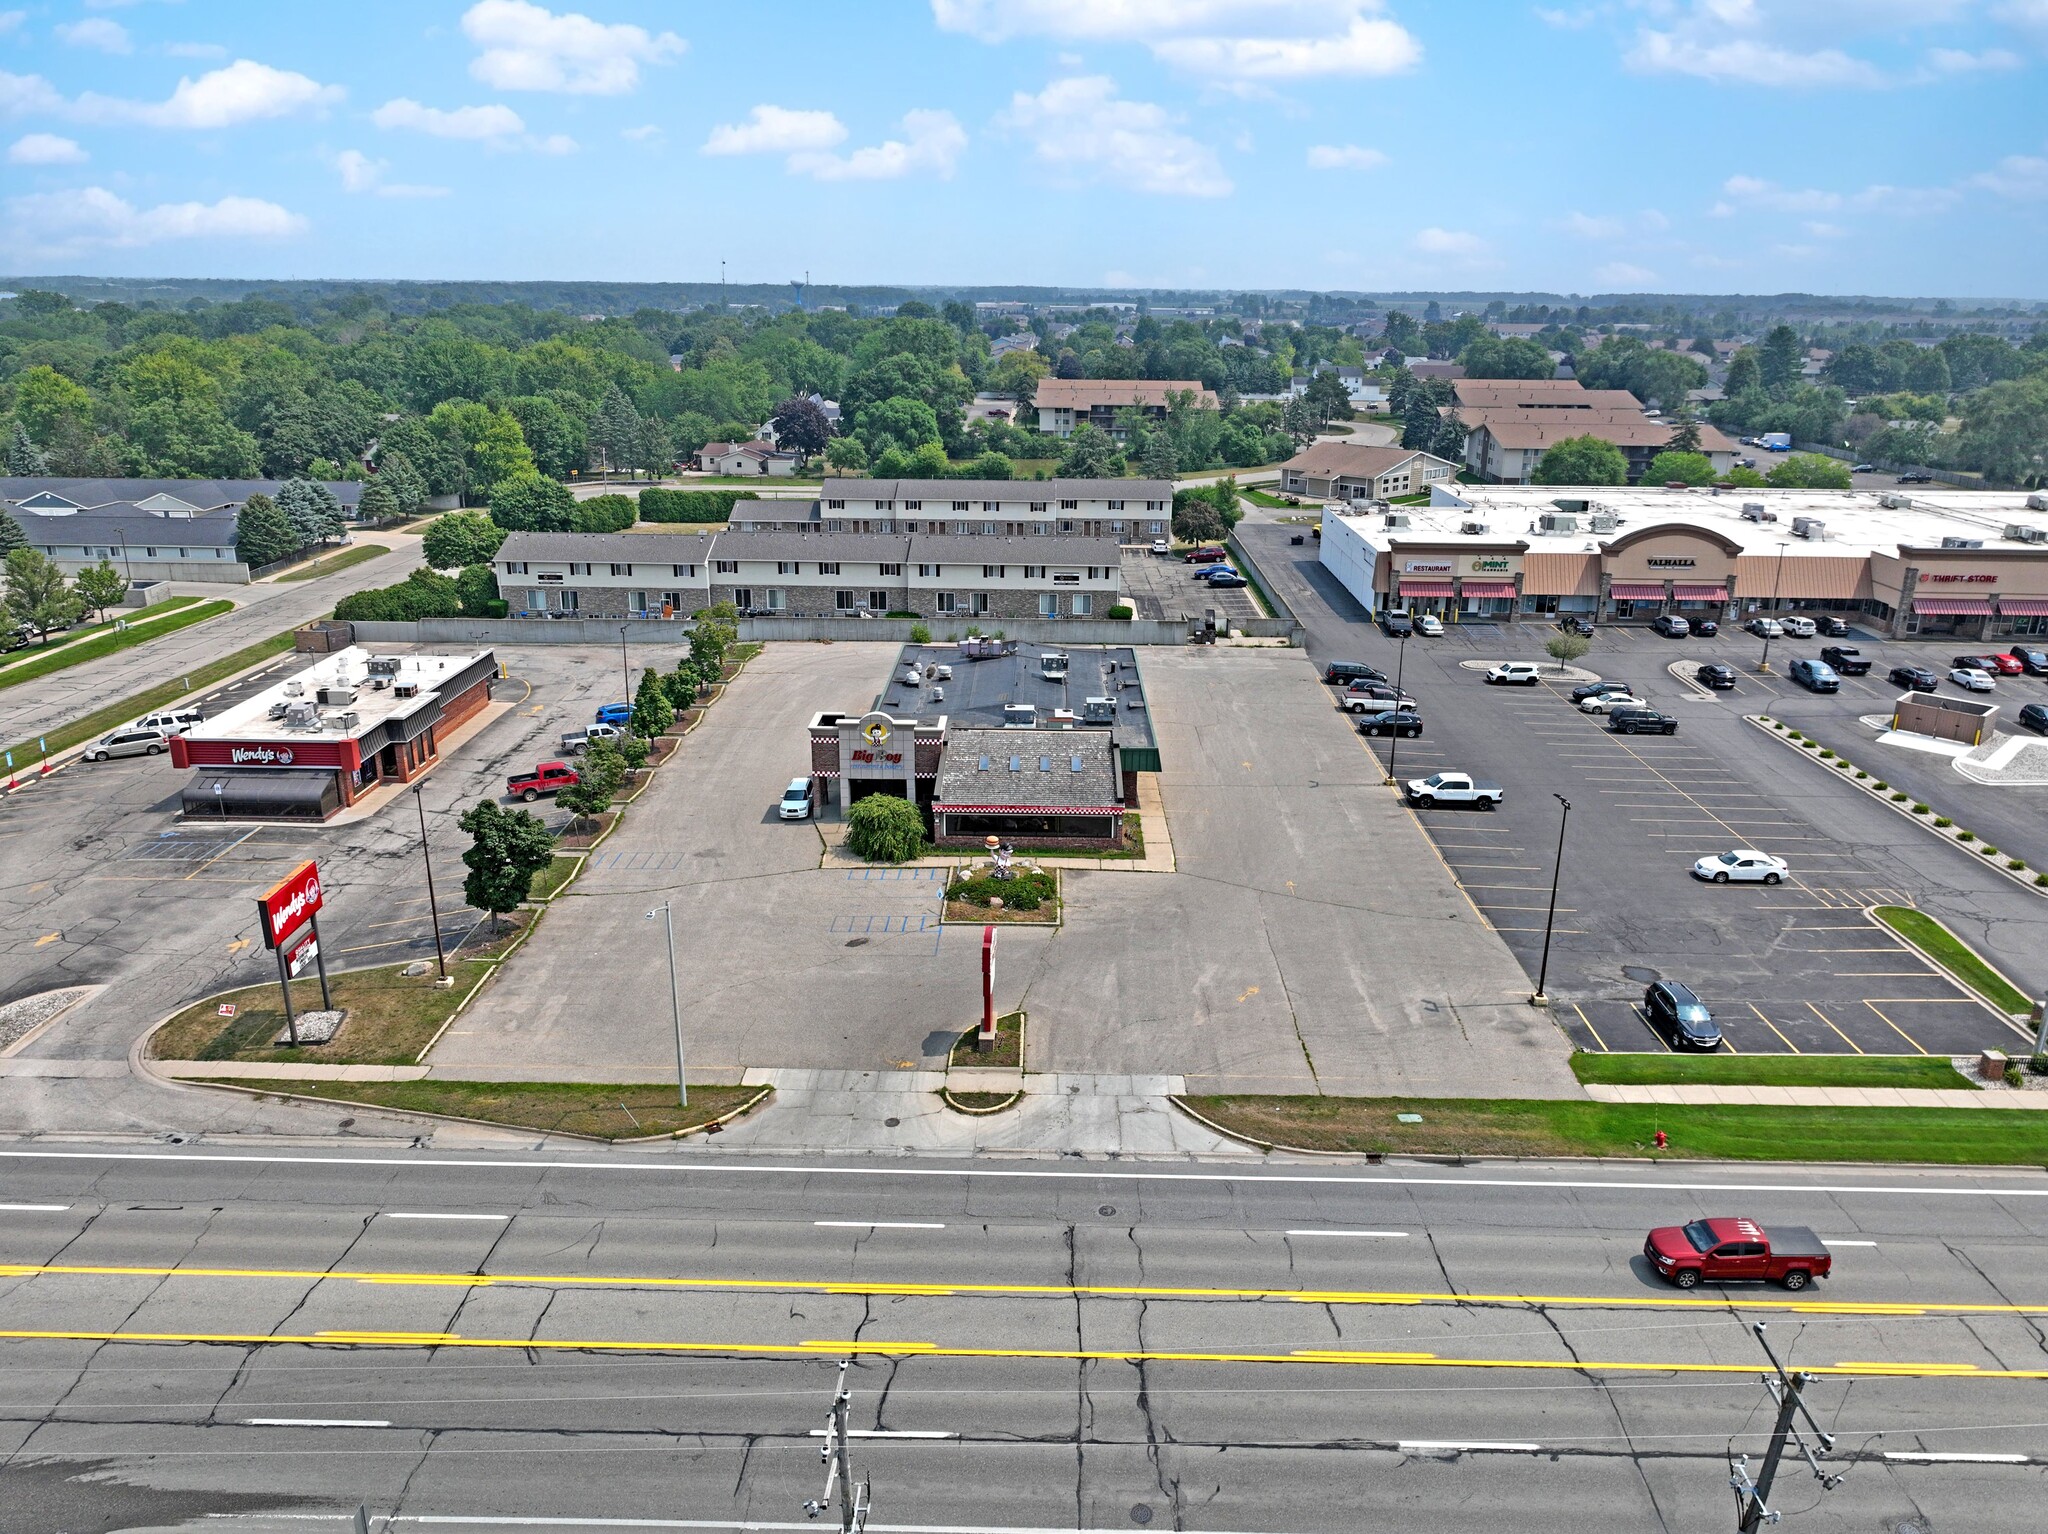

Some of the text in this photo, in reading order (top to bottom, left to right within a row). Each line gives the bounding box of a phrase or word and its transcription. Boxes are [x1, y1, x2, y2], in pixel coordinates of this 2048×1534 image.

[1647, 559, 1696, 567] VALHALLA
[1932, 575, 1998, 583] THRIFT STORE
[231, 746, 275, 764] Wendy's
[852, 750, 902, 764] Big Boy
[272, 891, 306, 935] Wendy's
